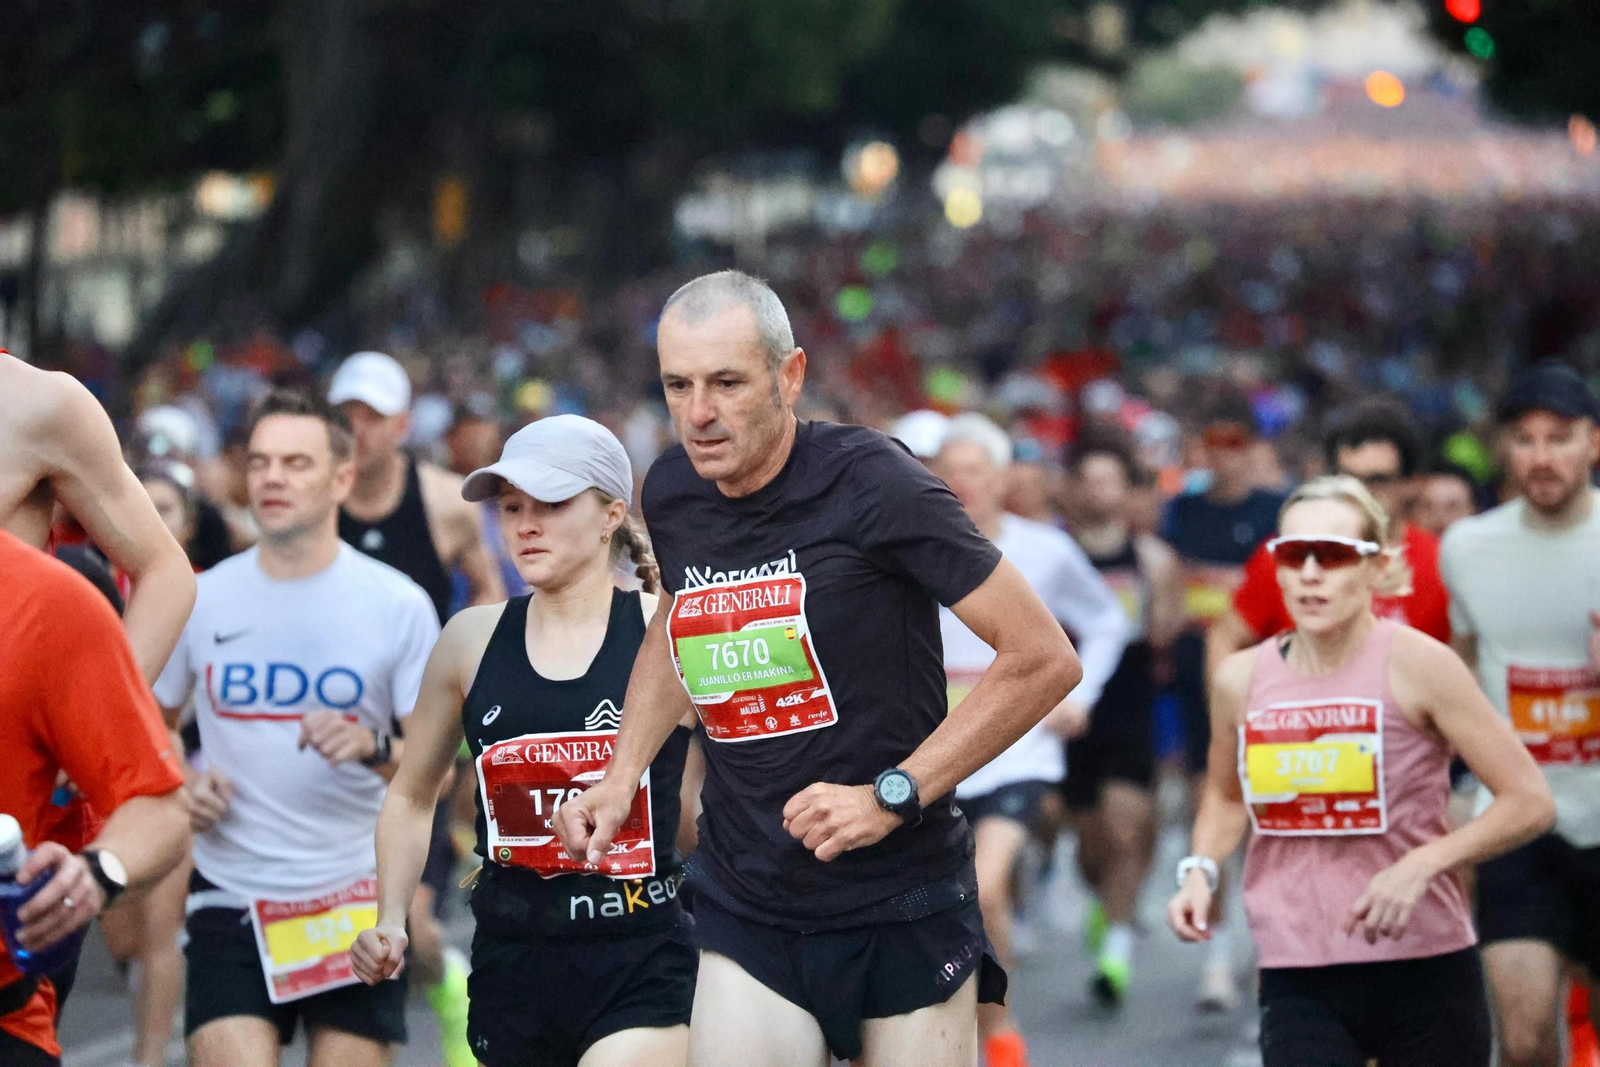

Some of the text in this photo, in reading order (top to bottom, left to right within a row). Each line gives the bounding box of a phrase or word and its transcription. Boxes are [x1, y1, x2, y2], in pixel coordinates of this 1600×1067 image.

[704, 584, 792, 615] GENERALI
[705, 638, 770, 670] 7670
[221, 662, 363, 709] BDO
[698, 665, 795, 687] JUANILLO ER MAKINA
[776, 693, 806, 708] 42K
[807, 710, 828, 719] renfe
[1278, 706, 1368, 731] GENERALI
[524, 740, 616, 764] GENERA
[1275, 748, 1339, 776] 3707
